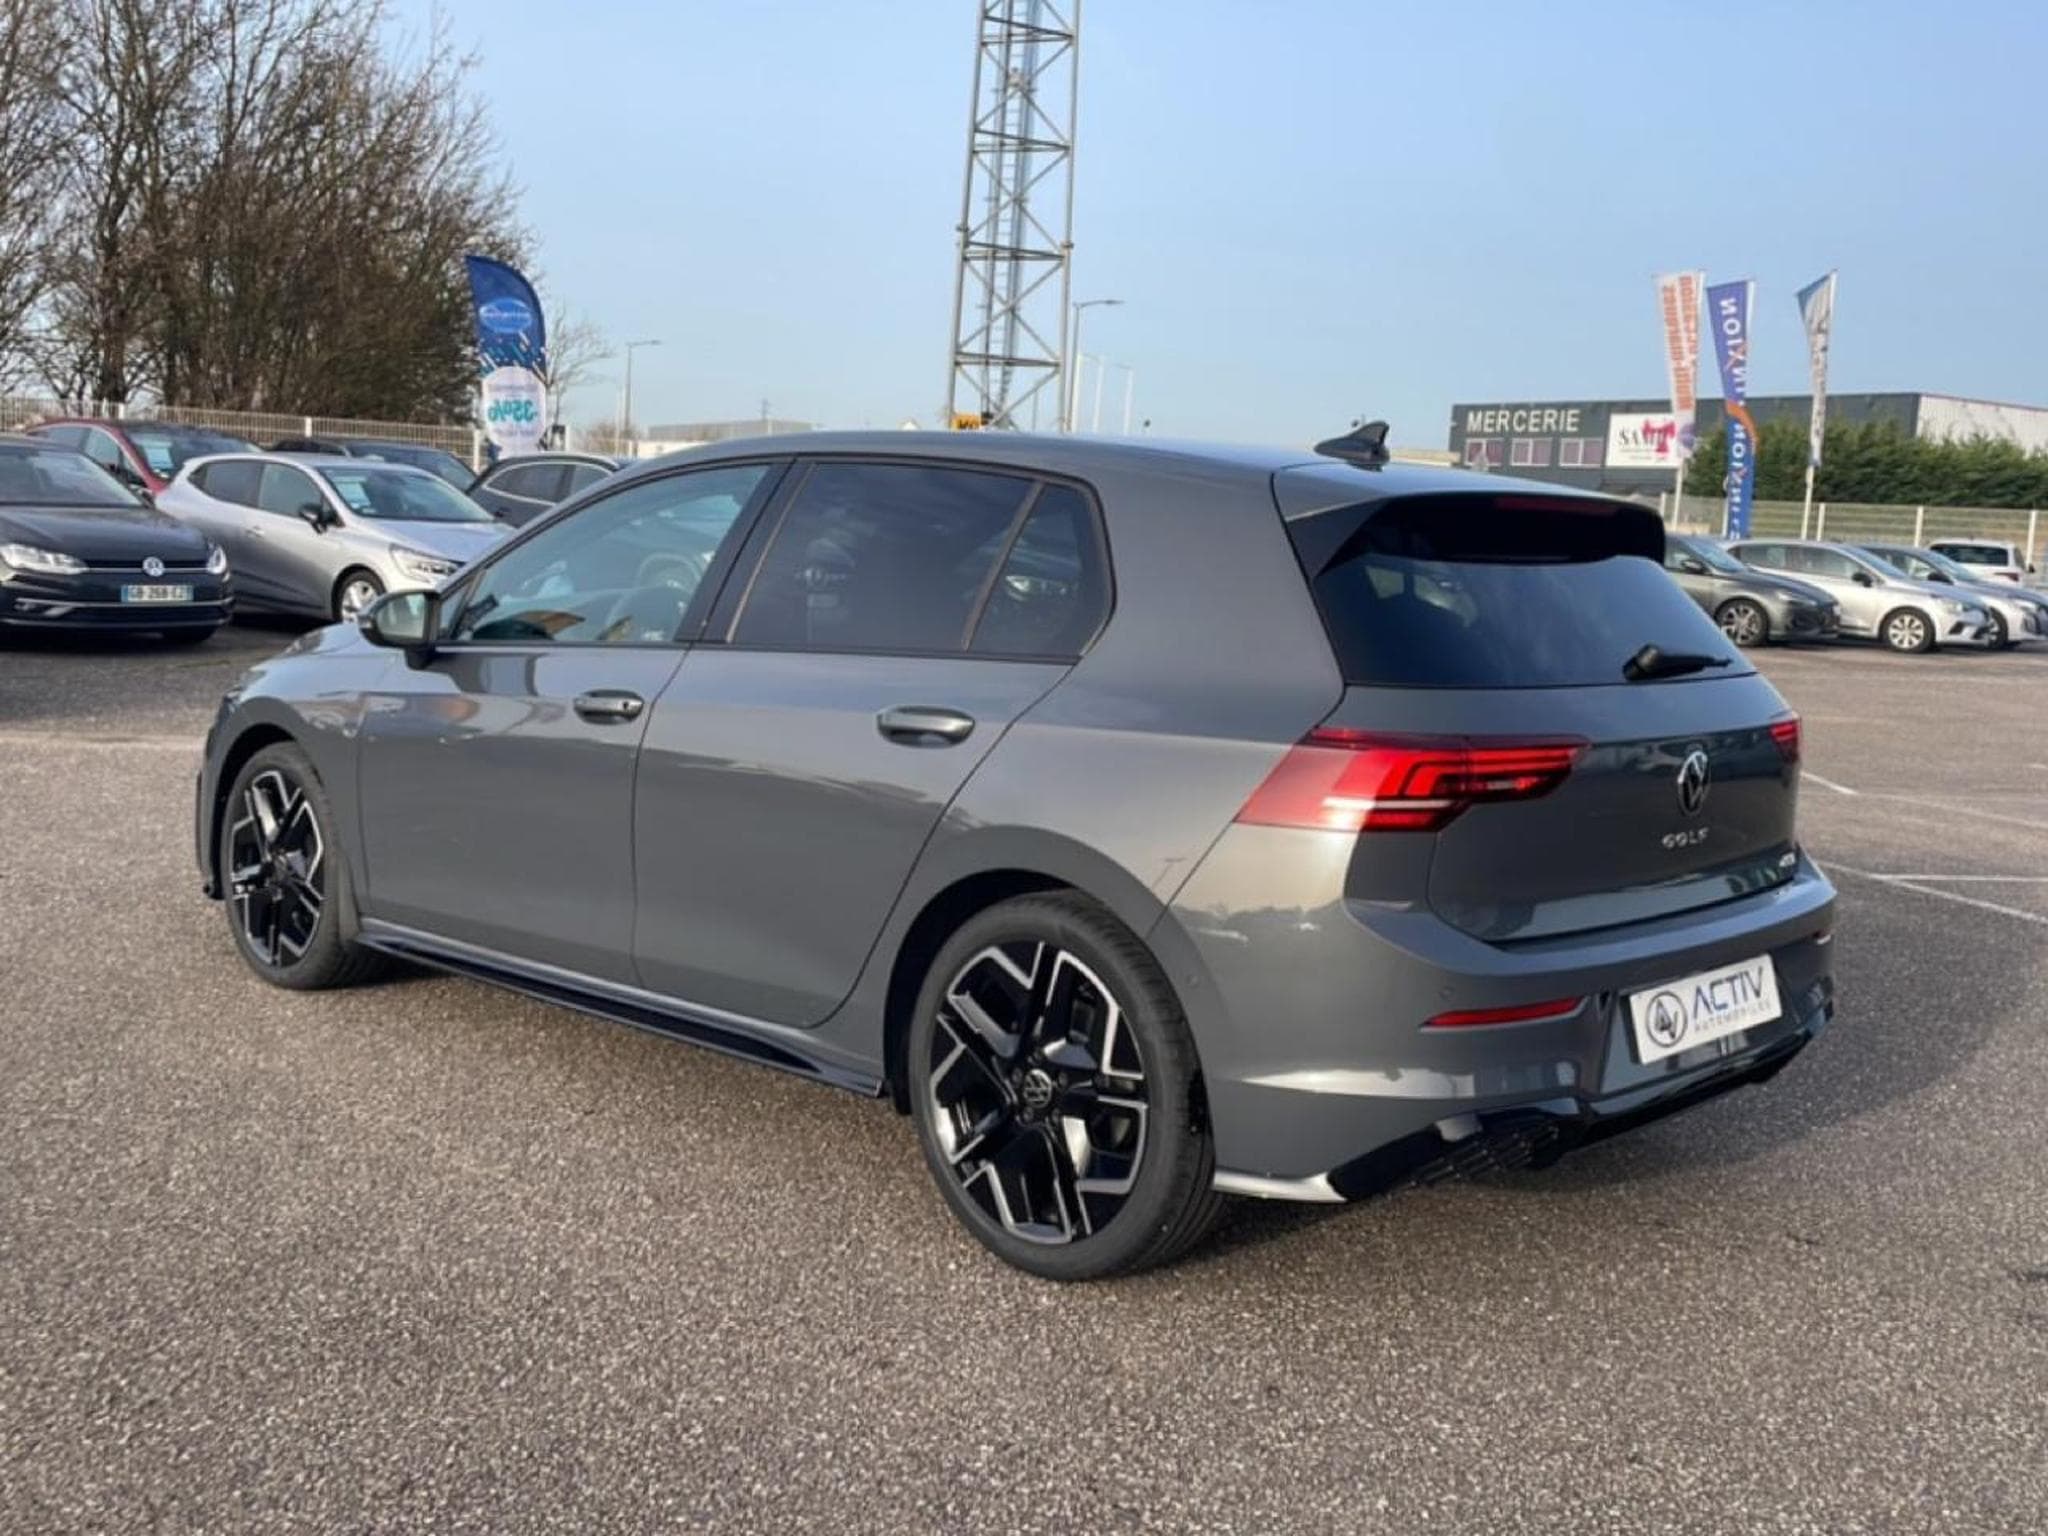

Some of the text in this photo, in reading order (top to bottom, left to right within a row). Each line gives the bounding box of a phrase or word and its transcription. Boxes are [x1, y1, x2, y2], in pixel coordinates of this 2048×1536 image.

[1466, 409, 1580, 432] MERCERIE
[1662, 827, 1709, 848] GOLF
[1693, 966, 1763, 1019] ACTIV
